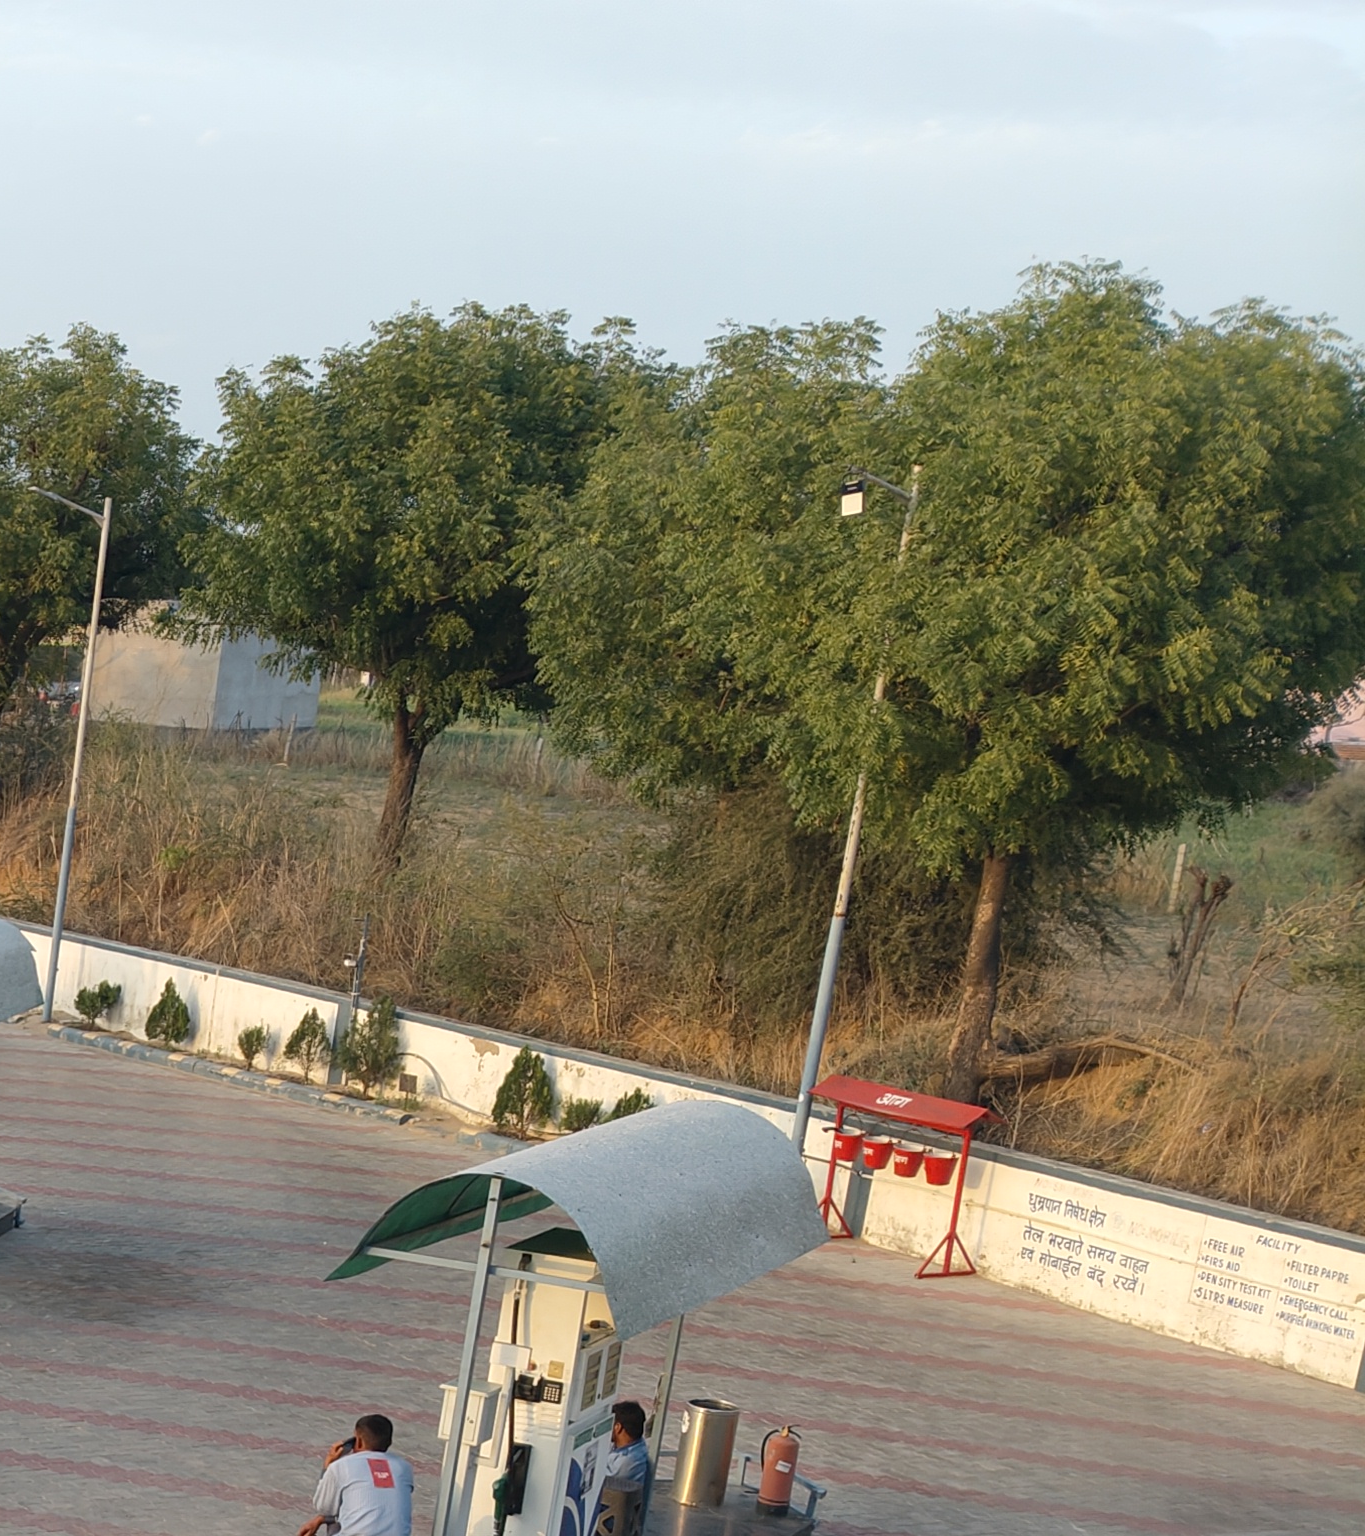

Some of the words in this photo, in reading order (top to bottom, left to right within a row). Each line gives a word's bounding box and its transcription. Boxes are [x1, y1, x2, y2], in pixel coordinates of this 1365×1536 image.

[875, 1093, 913, 1108] आग
[1020, 1246, 1035, 1262] एवं
[1023, 1220, 1044, 1243] तेल
[1048, 1235, 1084, 1256] भरवाते
[1086, 1244, 1117, 1264] समय
[1118, 1253, 1149, 1274] वाहन
[1208, 1239, 1228, 1254] FREE
[1230, 1245, 1245, 1258] AIR
[1256, 1235, 1302, 1255] FACILITY
[1226, 1261, 1241, 1272] AID
[1289, 1260, 1320, 1277] FILTER
[1320, 1267, 1349, 1285] PAPRE
[1239, 1282, 1258, 1297] TEST
[1258, 1287, 1272, 1300] KIT
[1287, 1277, 1319, 1293] TOILET
[1227, 1295, 1265, 1315] MEASURE
[1283, 1295, 1329, 1316] EMERGENCY
[1329, 1308, 1350, 1321] CALL
[1333, 1326, 1355, 1340] WATER
